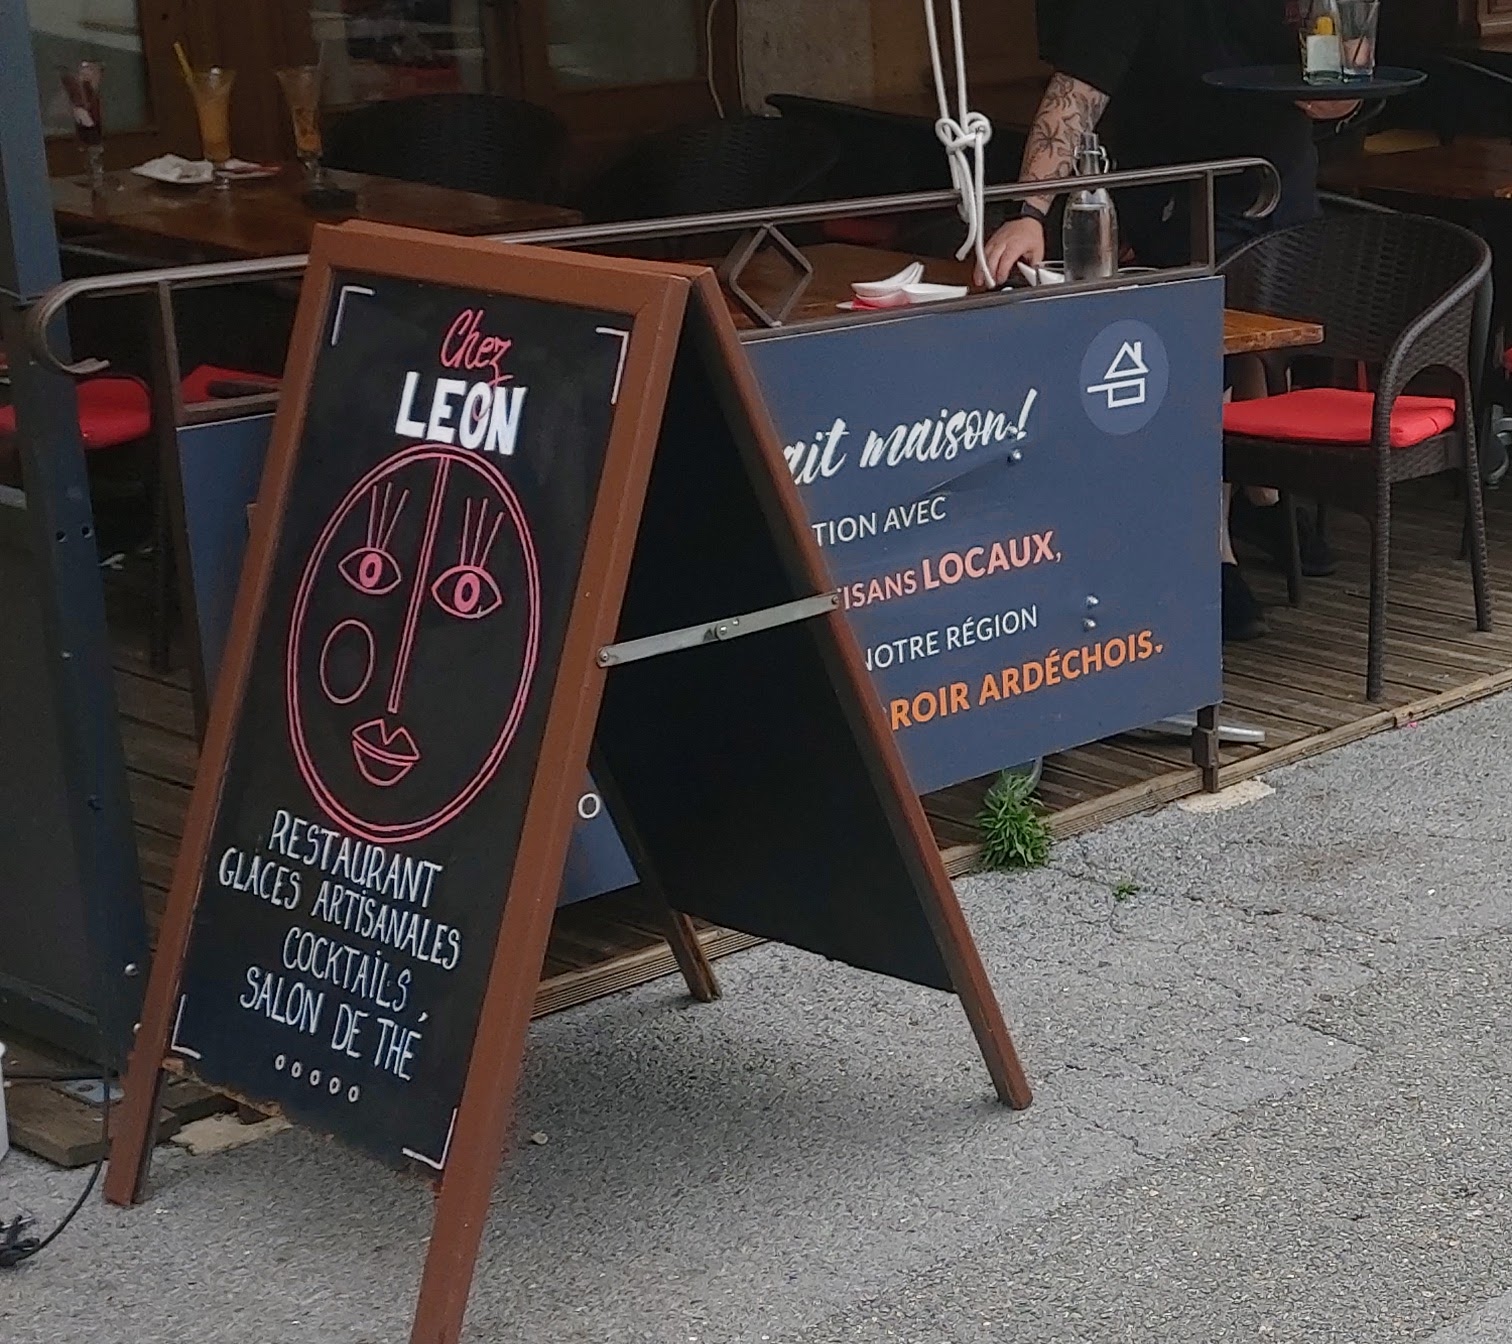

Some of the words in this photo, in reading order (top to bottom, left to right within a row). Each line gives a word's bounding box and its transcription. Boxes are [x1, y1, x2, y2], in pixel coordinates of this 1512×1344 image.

[440, 309, 514, 422] Chez
[395, 371, 528, 455] LEON
[883, 496, 948, 532] AVEC
[836, 569, 917, 610] ISANS
[922, 530, 1062, 590] LOCAUX,
[946, 604, 1038, 652] RÉGION
[883, 680, 970, 731] ROIR
[979, 629, 1164, 706] ARDÉCHOIS.
[268, 809, 444, 908] RESTAURANT
[282, 926, 412, 1012] COCKTAILS
[310, 878, 462, 971] ARTISANALES
[239, 965, 325, 1035] SALON
[331, 1002, 370, 1059] DE
